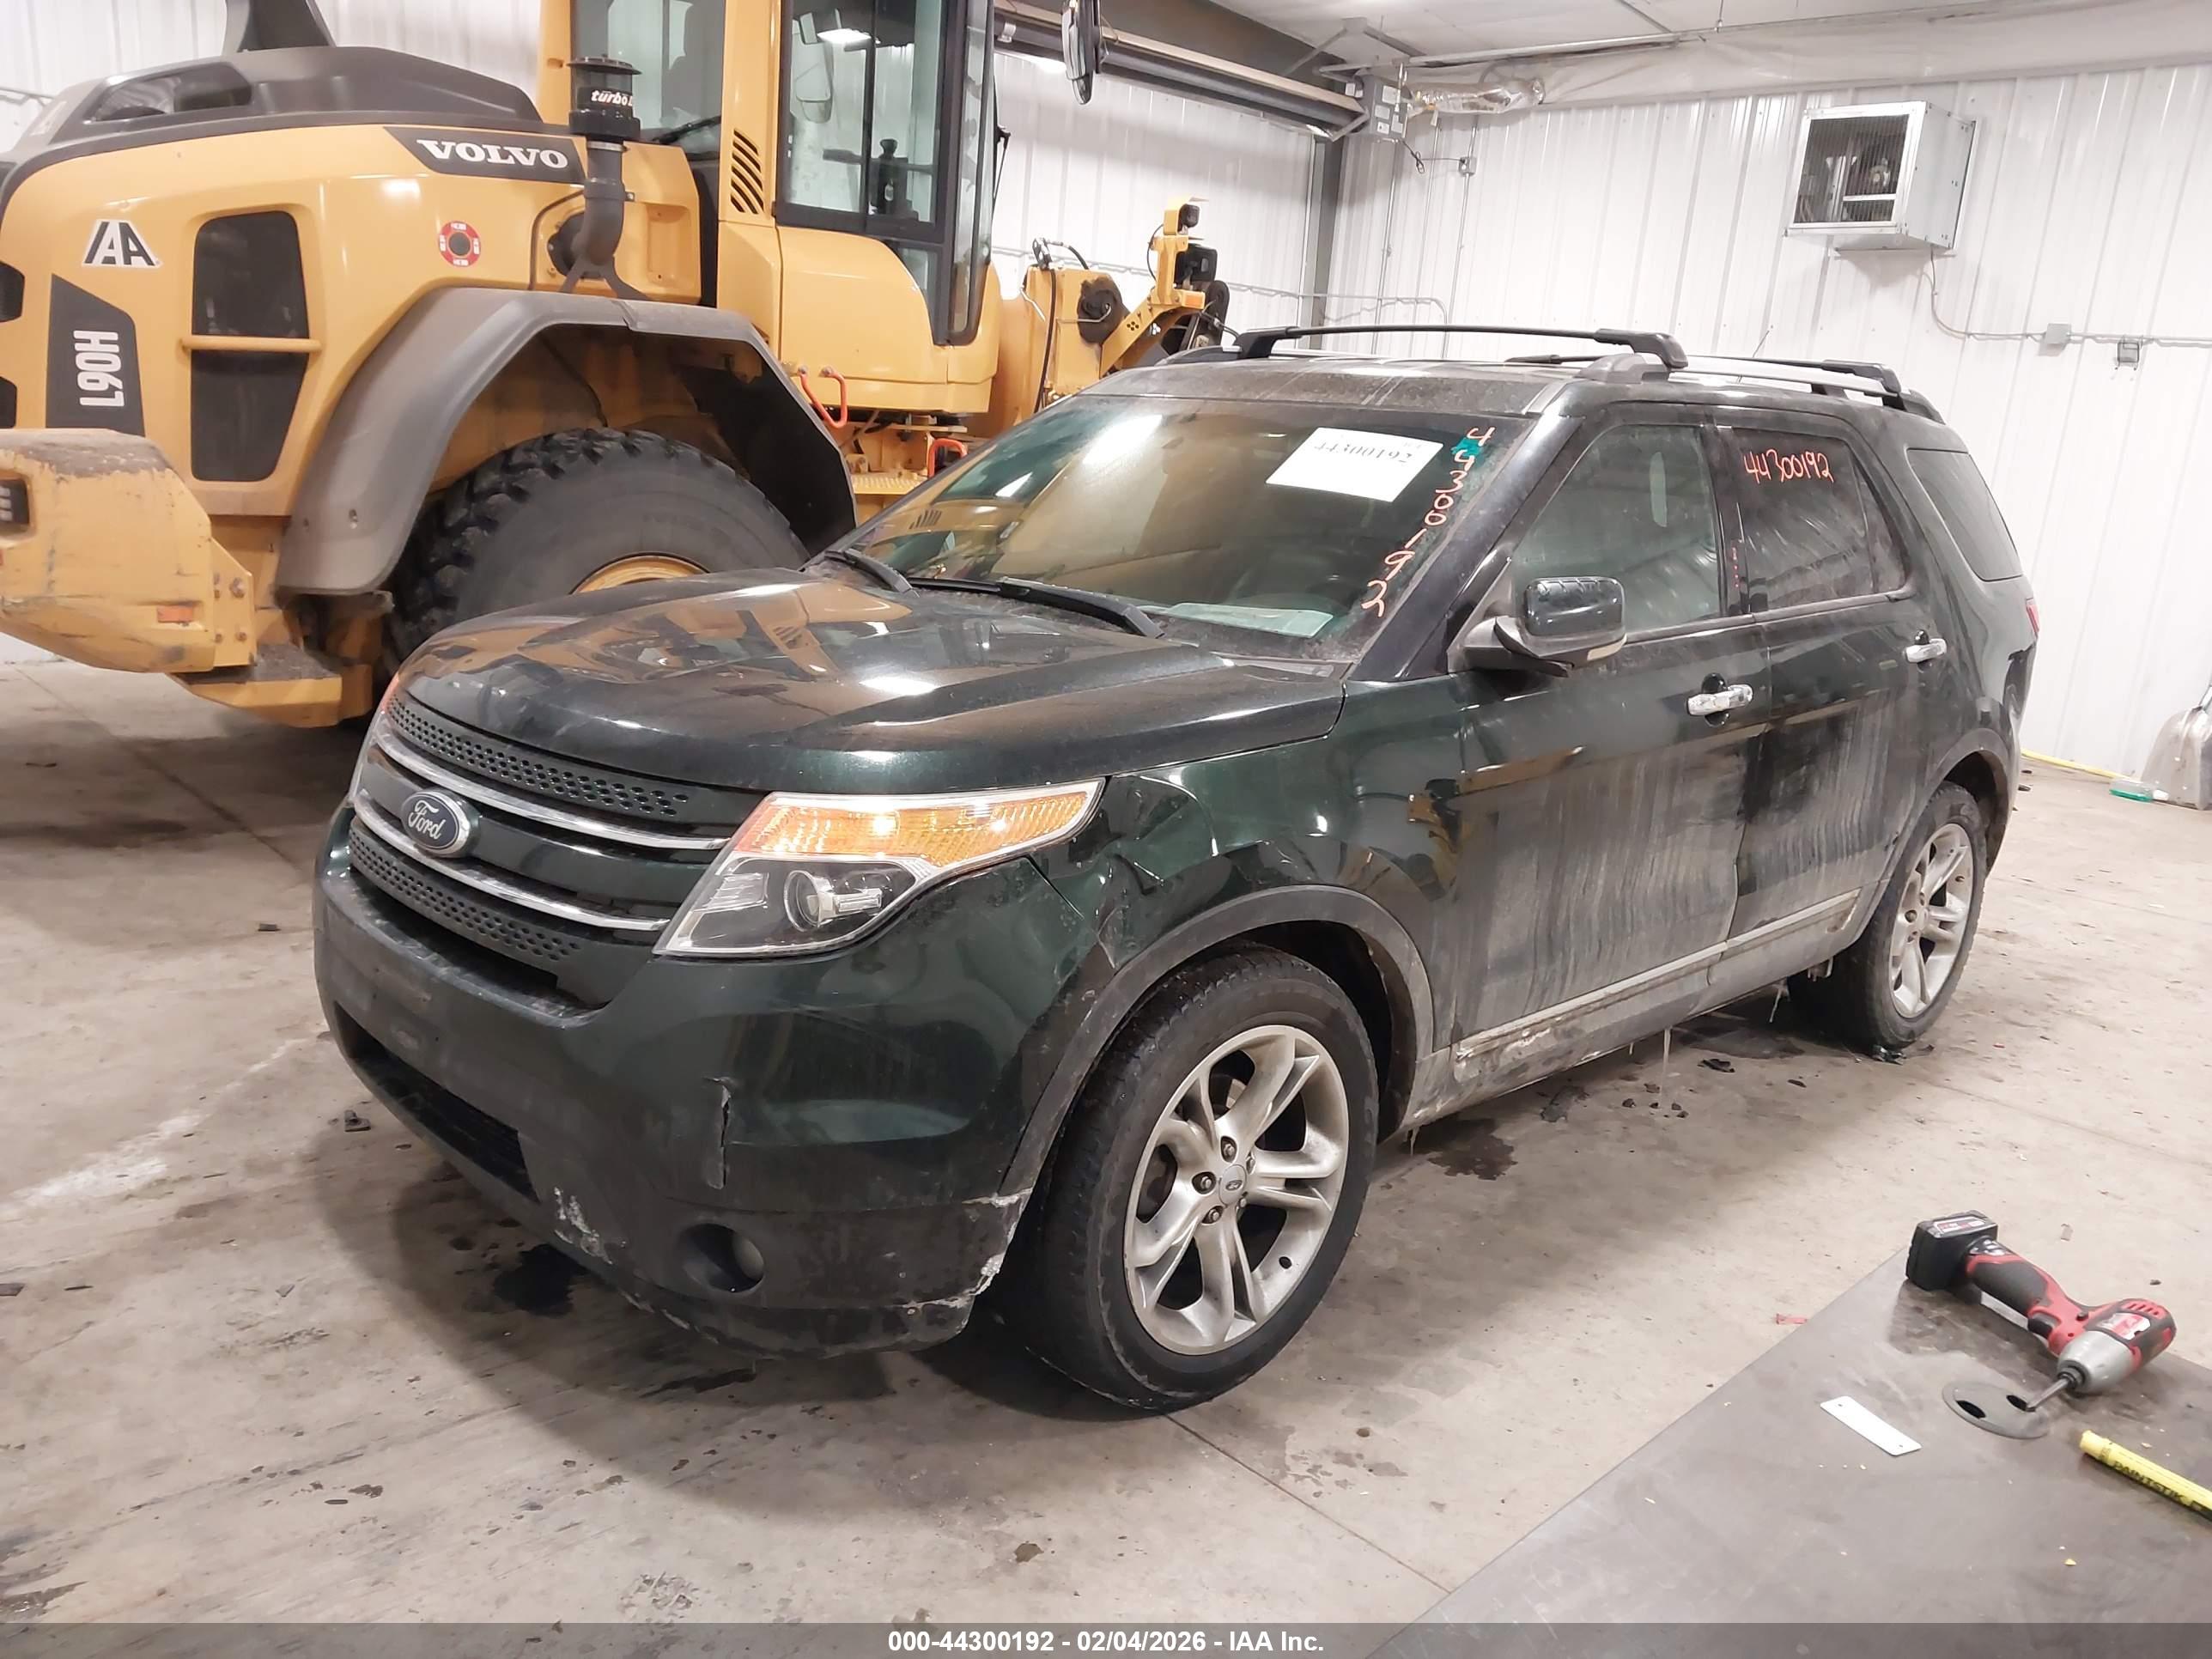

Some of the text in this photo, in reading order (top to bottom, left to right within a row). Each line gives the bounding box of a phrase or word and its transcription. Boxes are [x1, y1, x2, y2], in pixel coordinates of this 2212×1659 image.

[416, 139, 568, 168] VOLVO
[73, 330, 125, 407] L90H
[1743, 448, 1834, 484] 44300192
[408, 799, 447, 840] Ford
